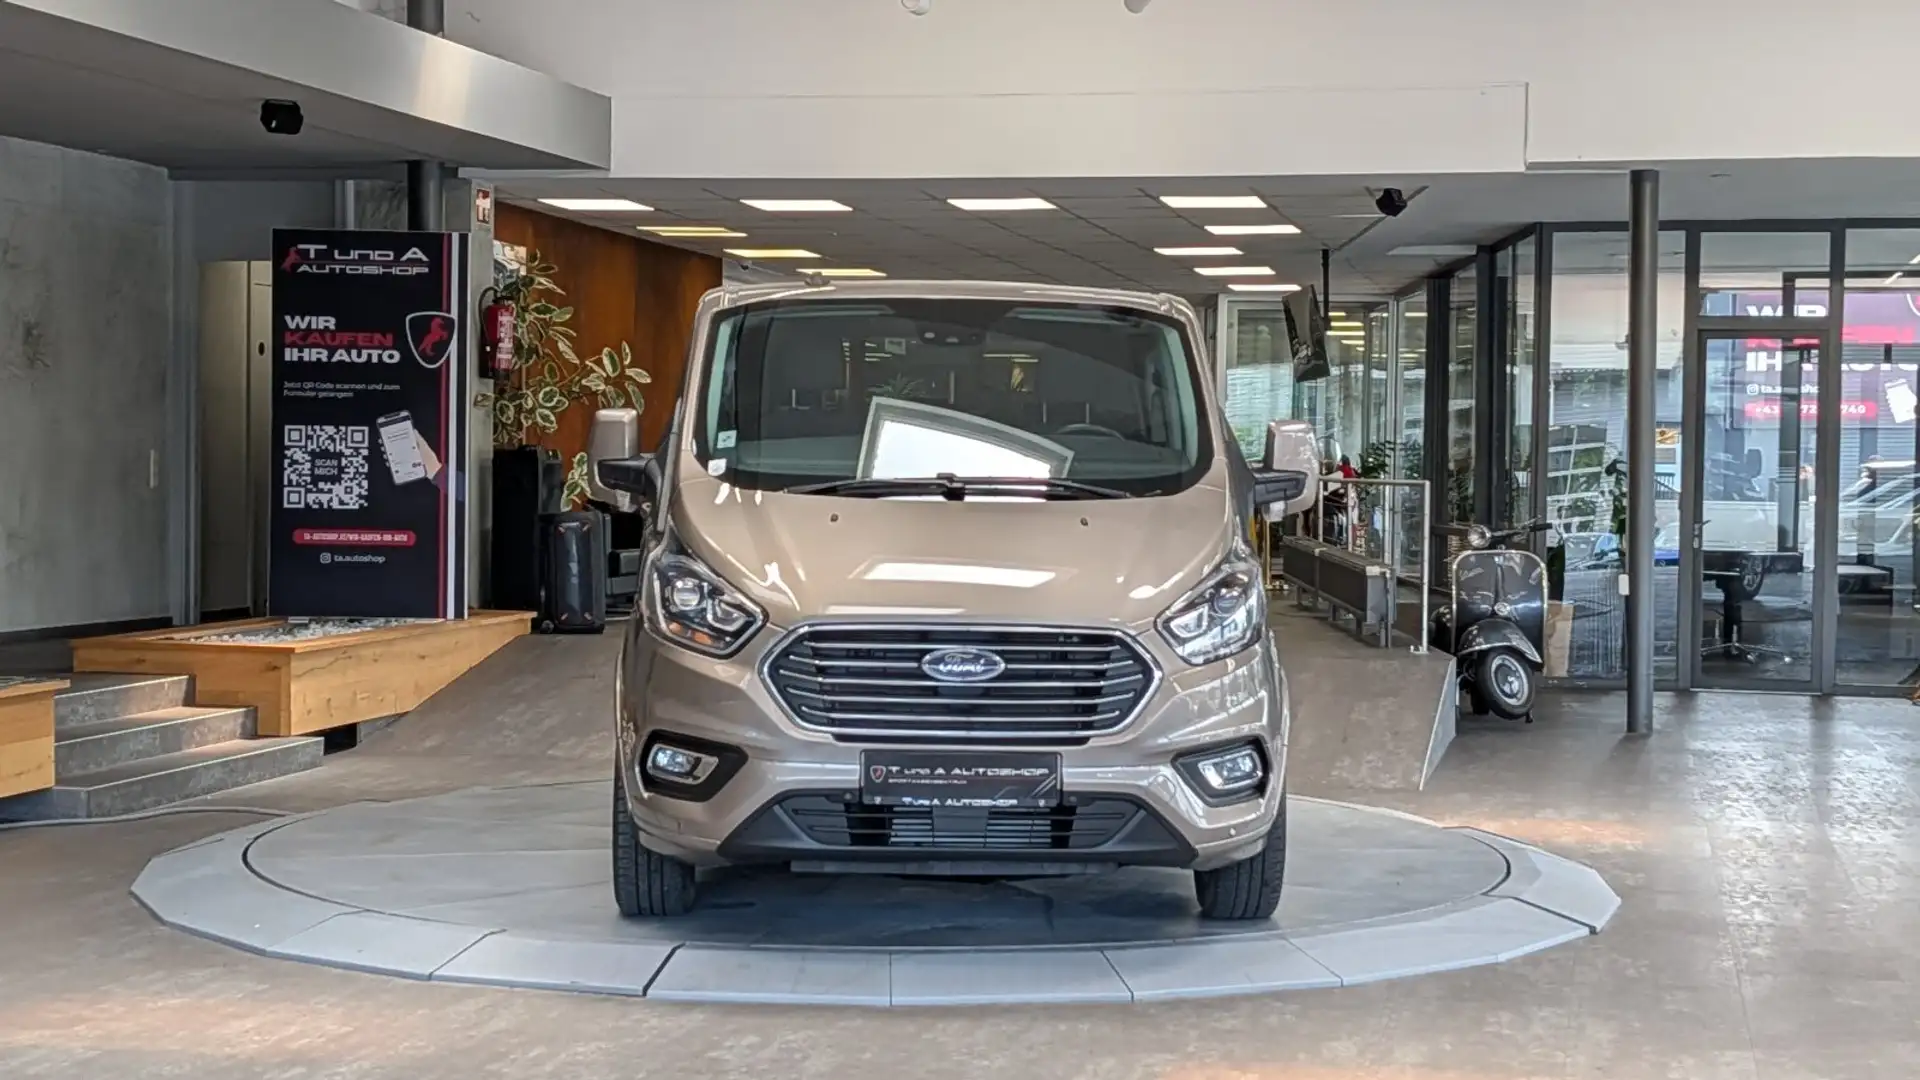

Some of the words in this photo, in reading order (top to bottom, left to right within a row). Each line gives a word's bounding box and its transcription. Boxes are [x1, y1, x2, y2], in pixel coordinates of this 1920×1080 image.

[297, 244, 327, 259] T
[400, 247, 430, 262] A
[296, 264, 430, 276] AUTOSHOP
[284, 315, 336, 330] WIR
[284, 332, 394, 347] KAUFEN
[284, 348, 329, 363] IHR
[331, 349, 401, 364] AUTO
[314, 458, 338, 467] SCAN
[314, 467, 338, 476] MICH
[333, 554, 386, 564] ta.autoshop
[934, 767, 946, 776] A
[950, 767, 1049, 777] AUTOSHOP
